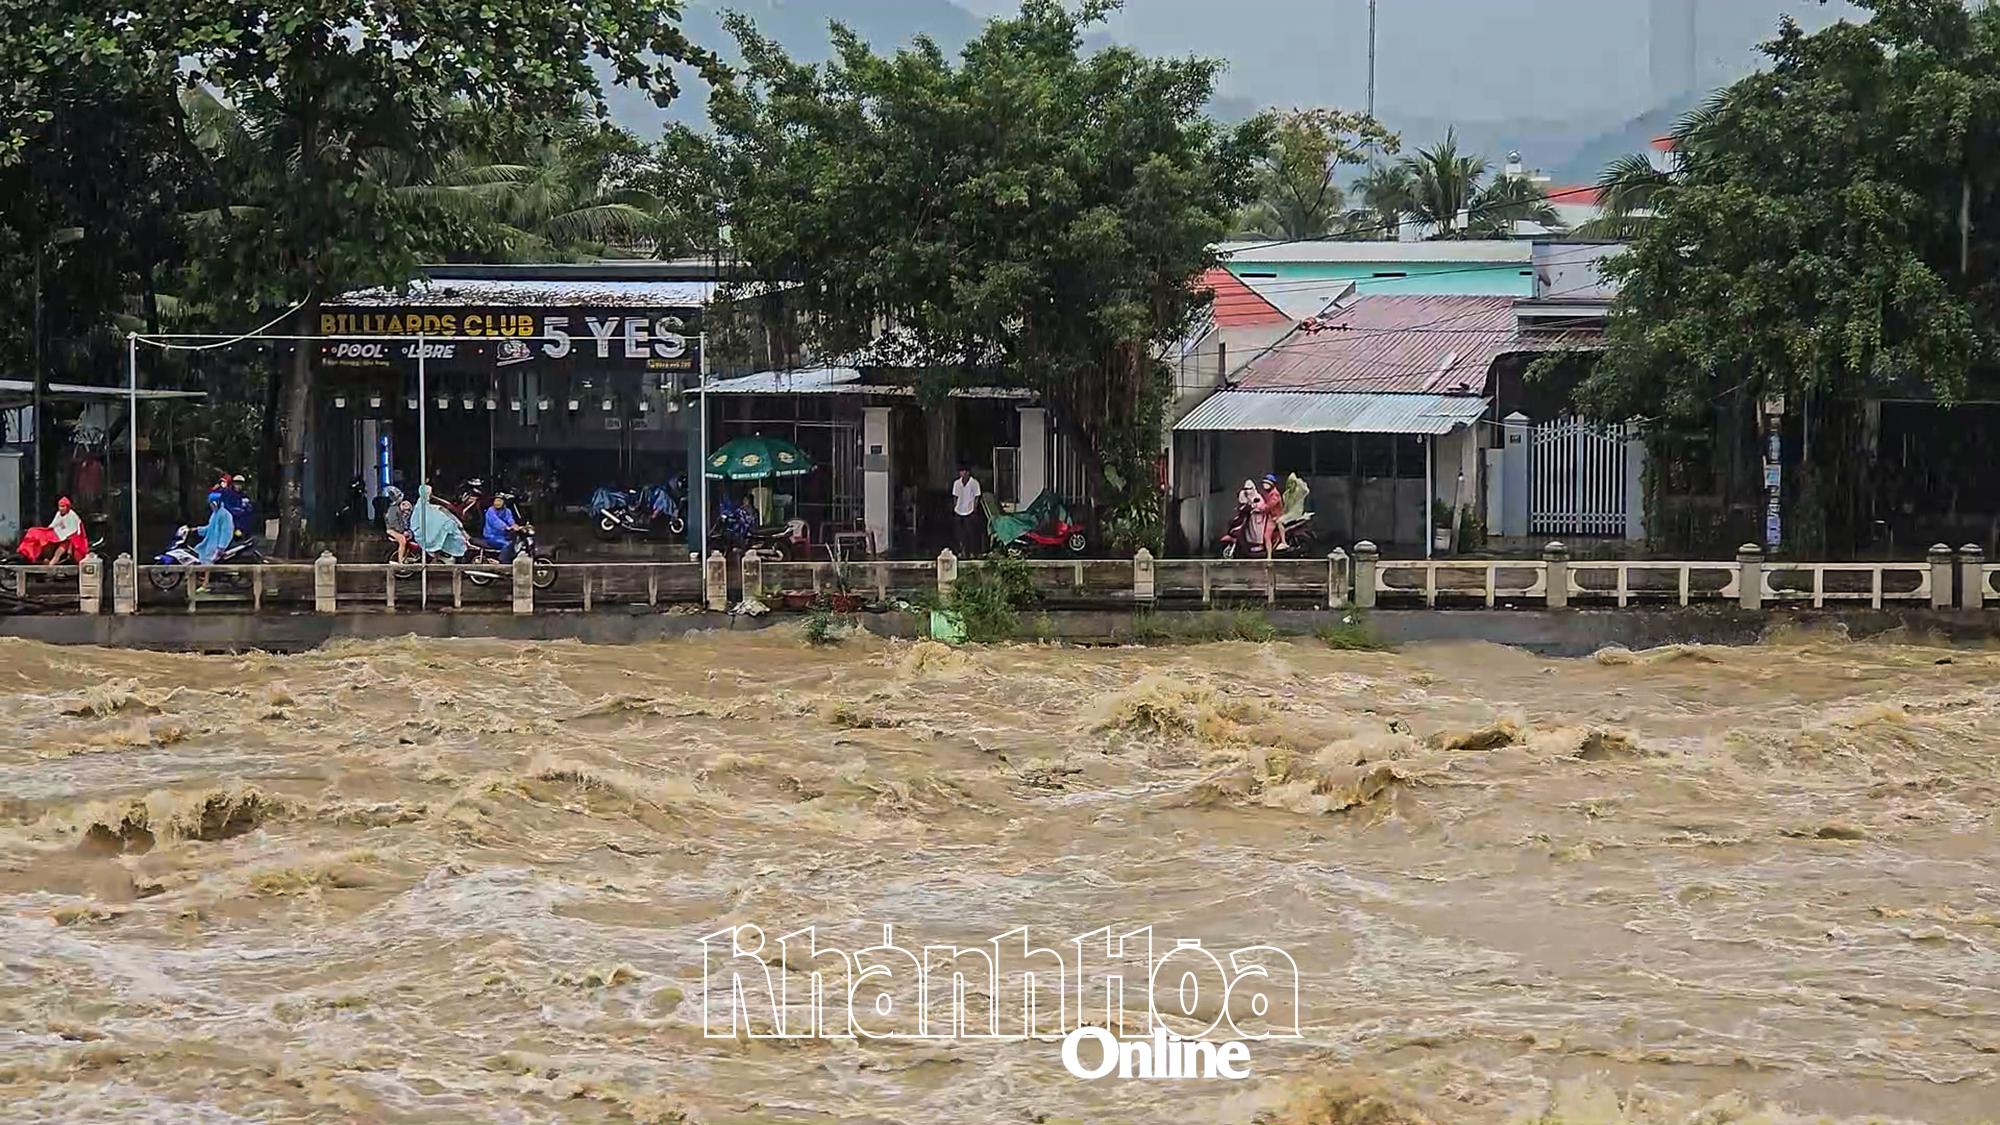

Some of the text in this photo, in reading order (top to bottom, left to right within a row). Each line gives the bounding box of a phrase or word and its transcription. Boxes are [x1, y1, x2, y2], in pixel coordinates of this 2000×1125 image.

[320, 314, 534, 336] BILLIARDS CLUB
[544, 316, 686, 359] 5 YES
[336, 343, 384, 358] POOL
